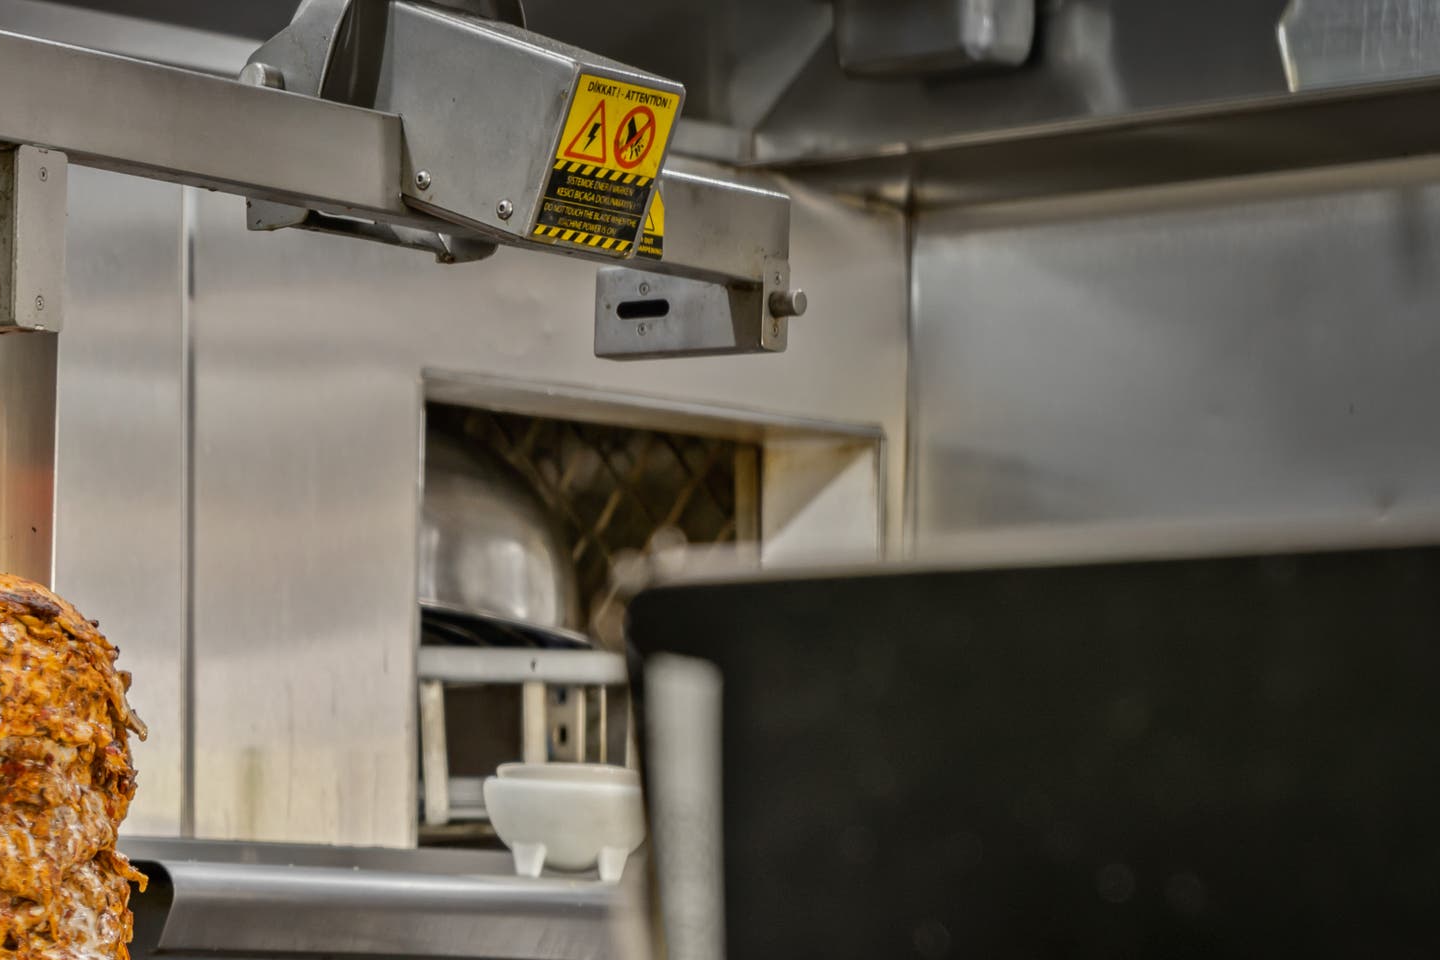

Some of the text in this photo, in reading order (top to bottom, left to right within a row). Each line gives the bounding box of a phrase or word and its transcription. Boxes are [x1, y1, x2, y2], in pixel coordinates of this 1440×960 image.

[625, 89, 668, 108] ATTENTION
[565, 206, 583, 217] TOUCH
[583, 209, 594, 219] THE
[582, 221, 602, 233] POWER
